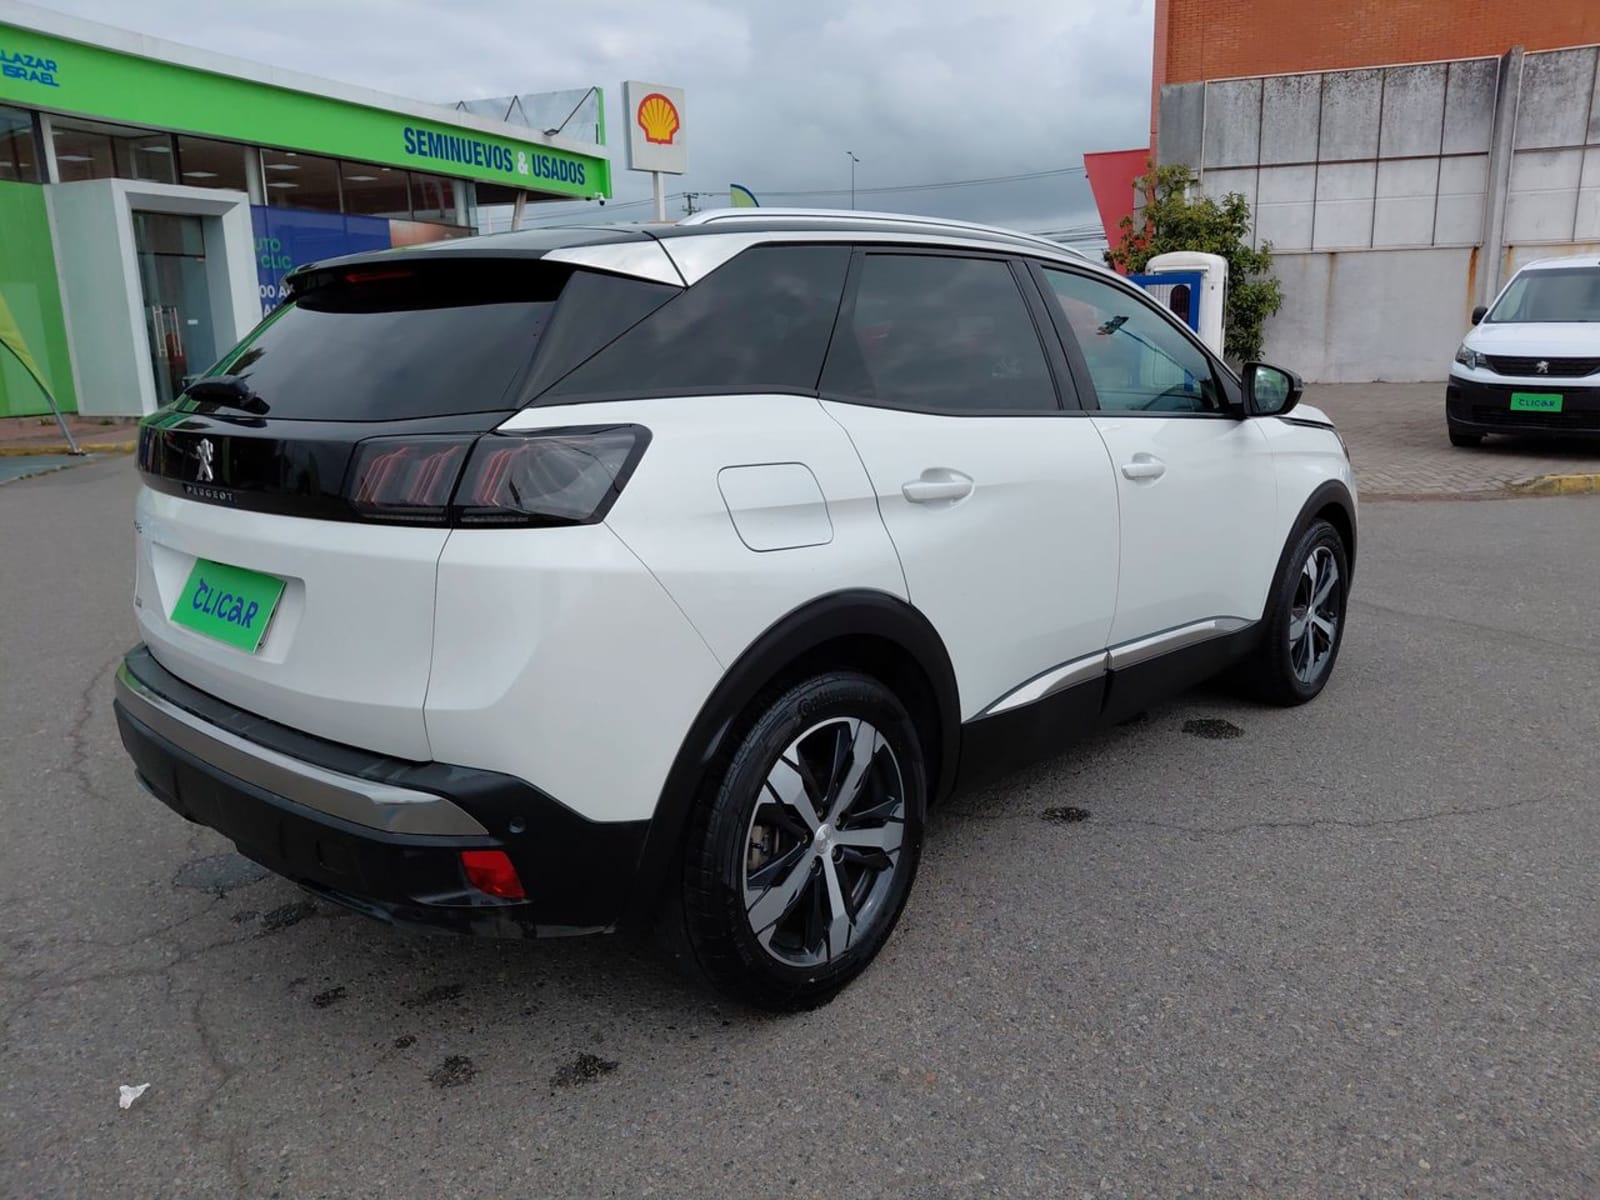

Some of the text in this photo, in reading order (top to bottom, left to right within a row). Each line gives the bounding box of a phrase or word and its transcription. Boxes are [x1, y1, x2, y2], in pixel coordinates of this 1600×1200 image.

[0, 50, 58, 73] LAZAR
[403, 126, 586, 186] SEMINUEVOS & USADOS
[186, 485, 233, 502] PEUGEOT
